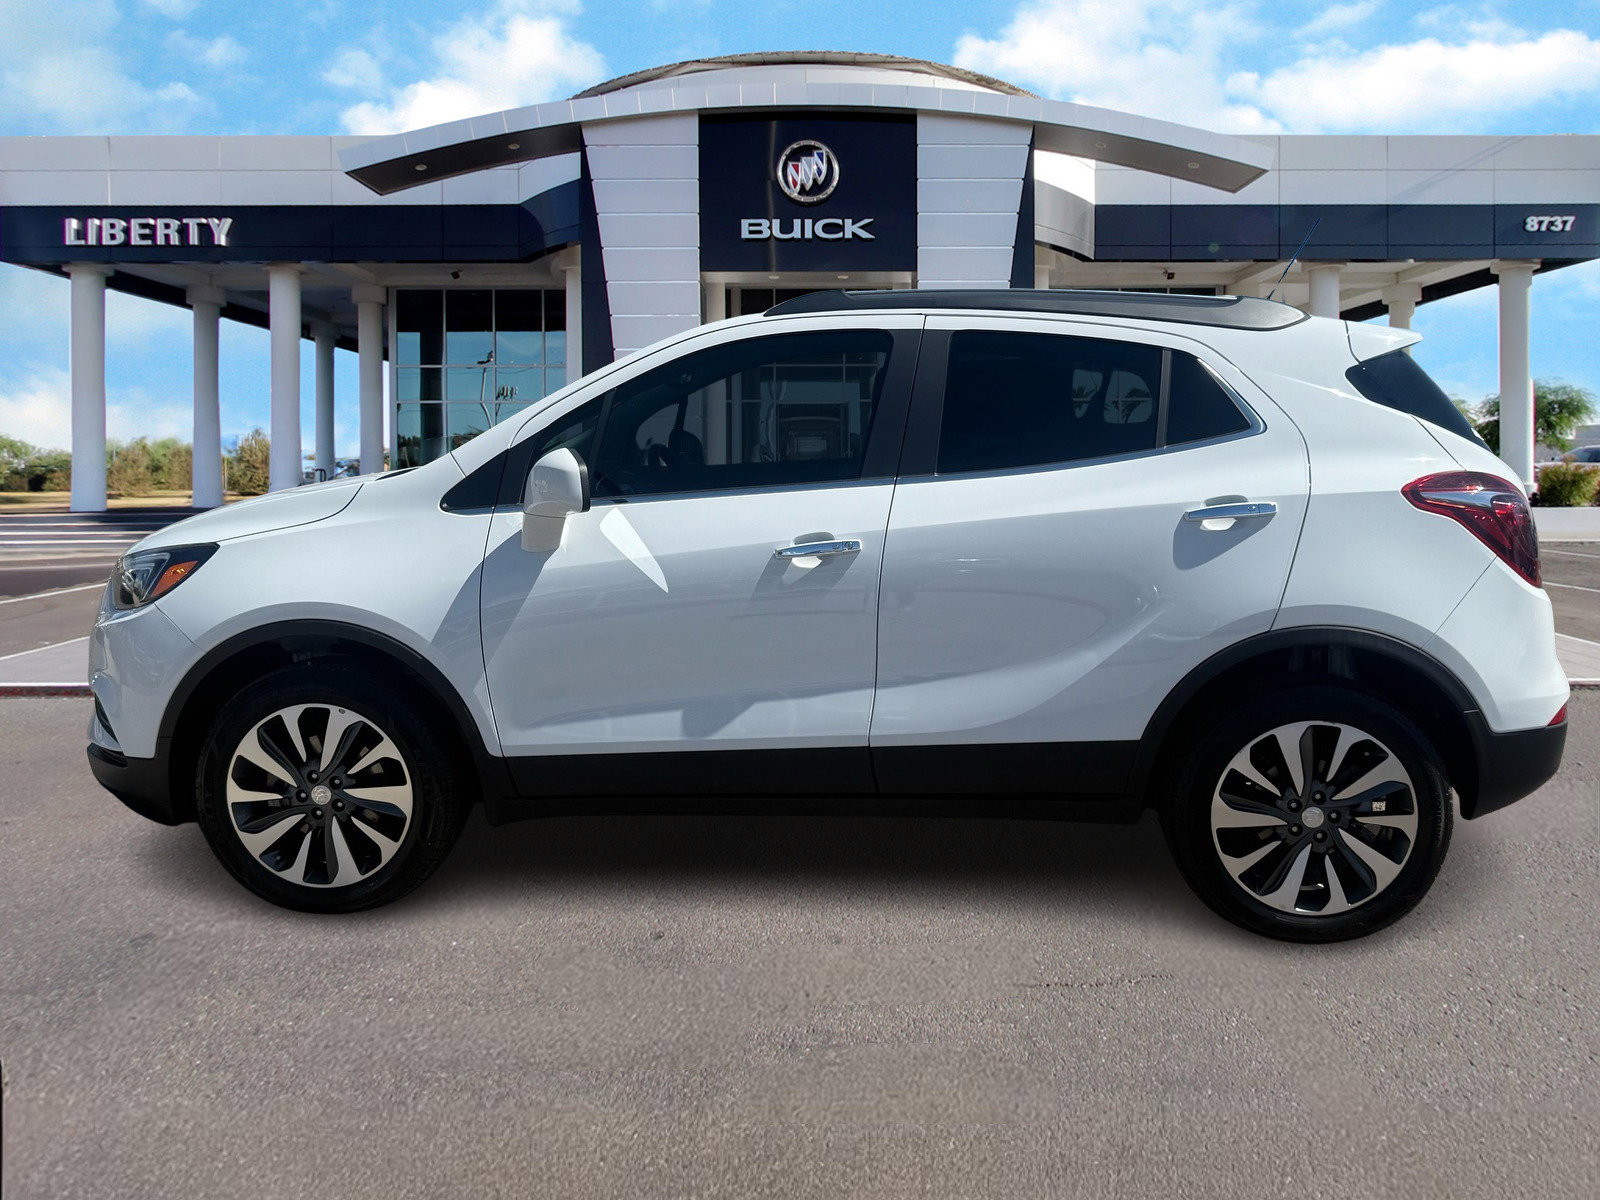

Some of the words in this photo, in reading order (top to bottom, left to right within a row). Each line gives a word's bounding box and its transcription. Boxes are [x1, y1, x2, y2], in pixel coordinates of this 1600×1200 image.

[64, 217, 233, 246] LIBERTY
[740, 218, 876, 239] BUICK
[1524, 215, 1576, 232] 8737
